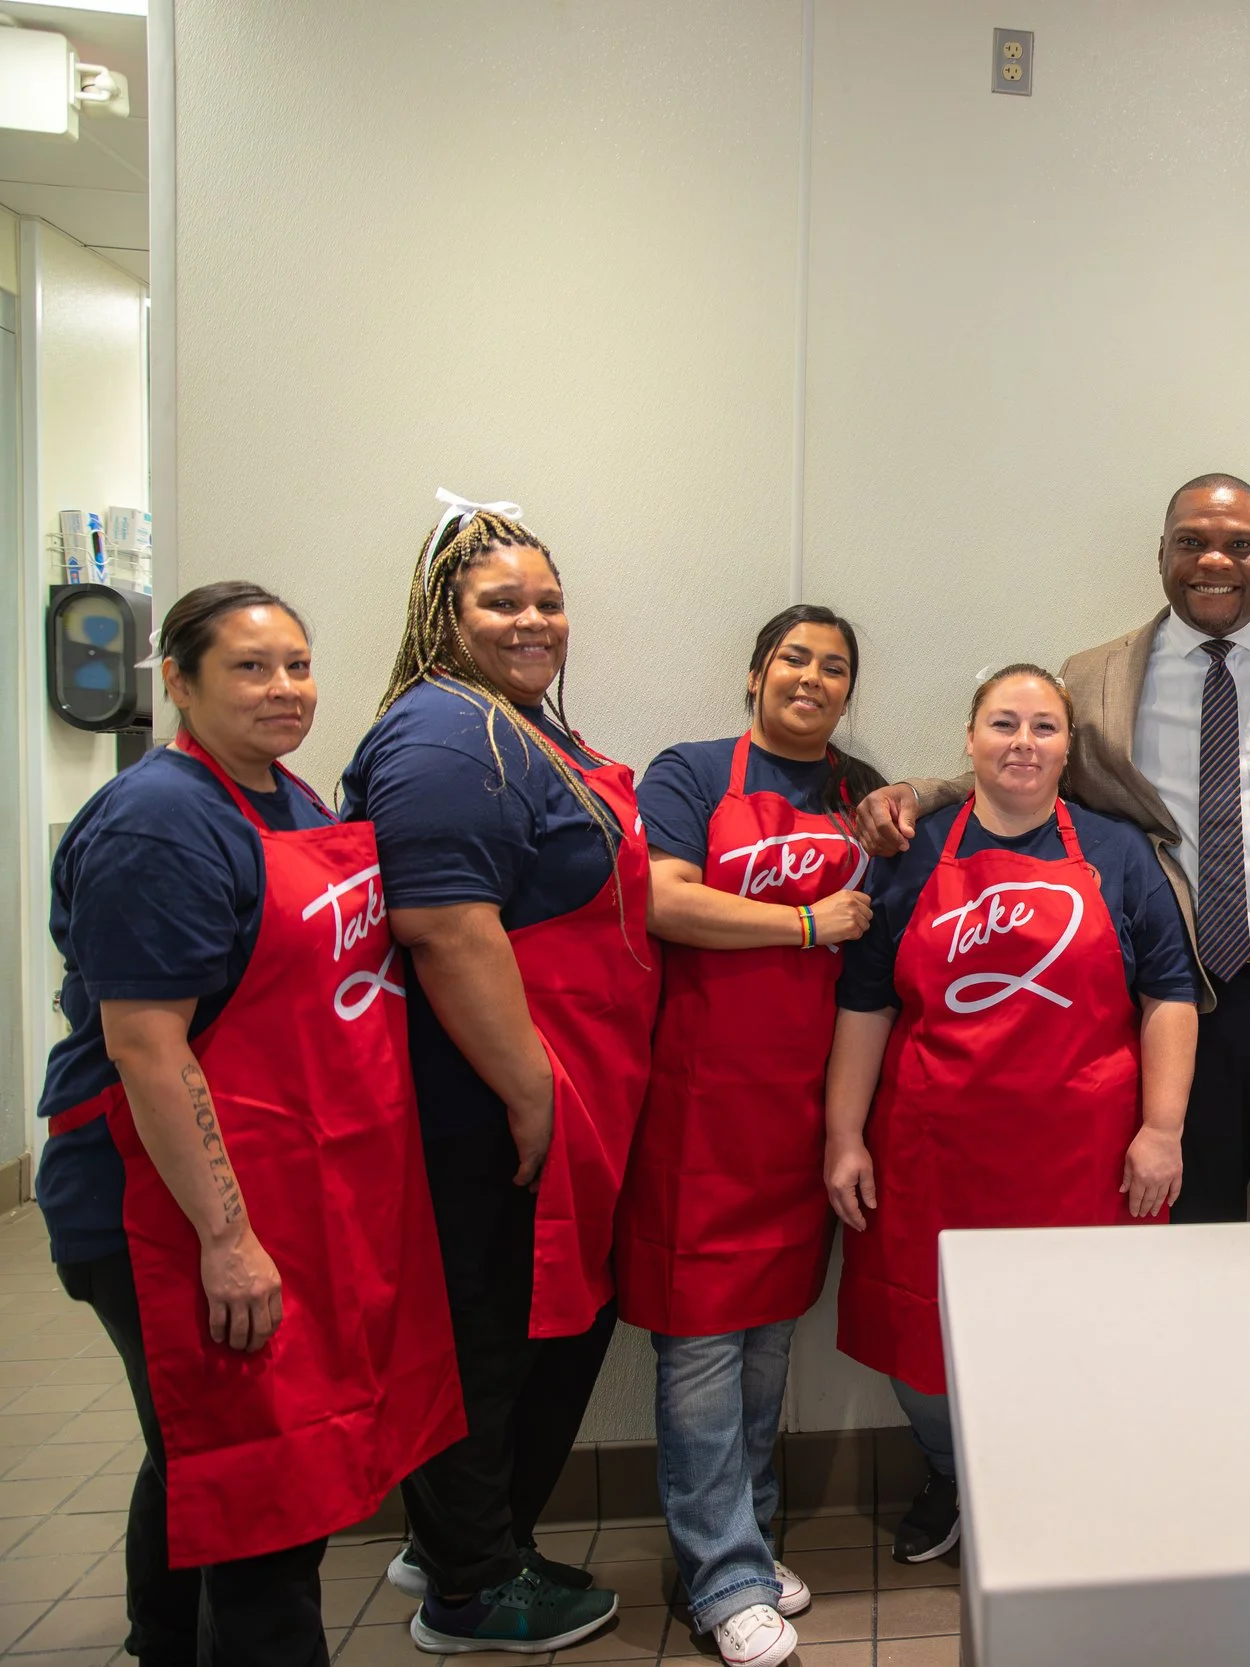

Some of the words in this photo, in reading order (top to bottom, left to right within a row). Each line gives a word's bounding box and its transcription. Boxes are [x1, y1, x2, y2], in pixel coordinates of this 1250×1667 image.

[720, 839, 825, 897] Take
[932, 892, 1035, 964] Take
[944, 880, 1085, 1014] 2
